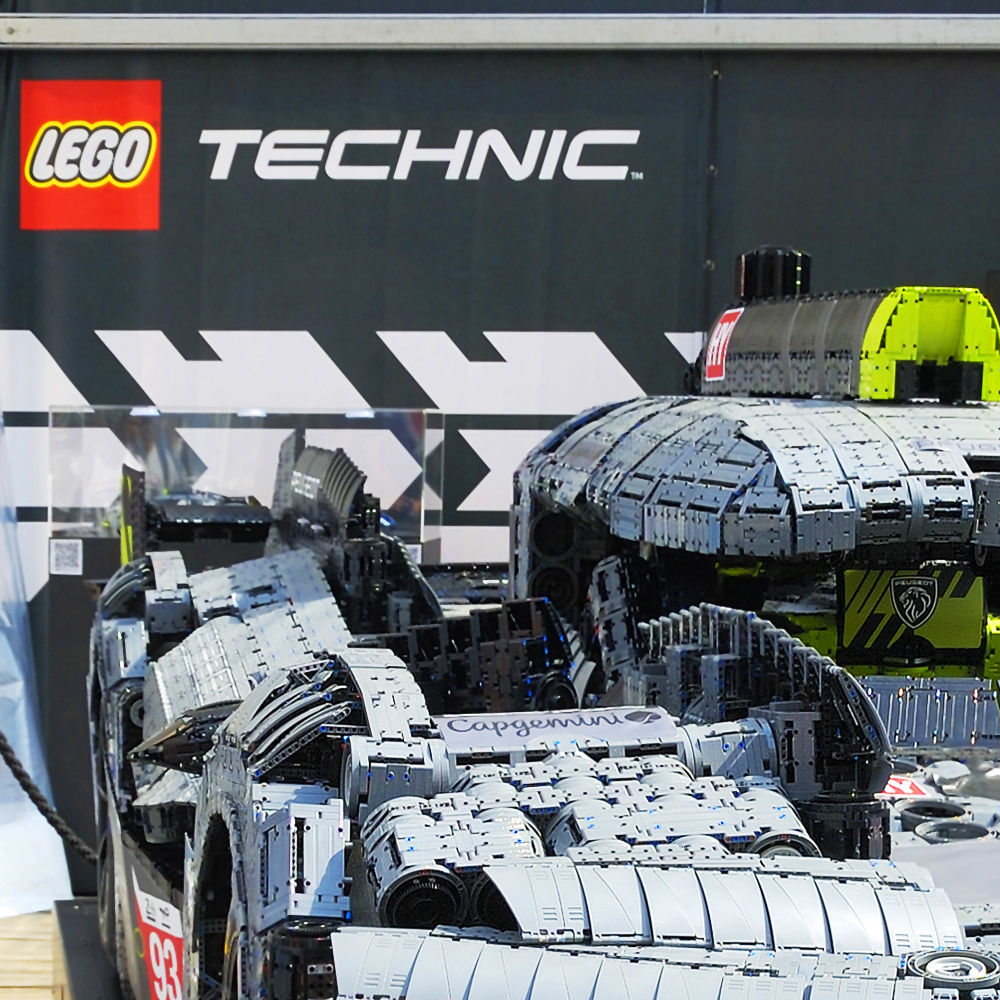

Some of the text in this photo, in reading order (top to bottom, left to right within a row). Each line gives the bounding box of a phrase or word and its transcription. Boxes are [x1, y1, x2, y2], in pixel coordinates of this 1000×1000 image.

[28, 124, 154, 185] LEGO
[199, 129, 641, 181] TECHNIC
[447, 712, 624, 737] Capgemini
